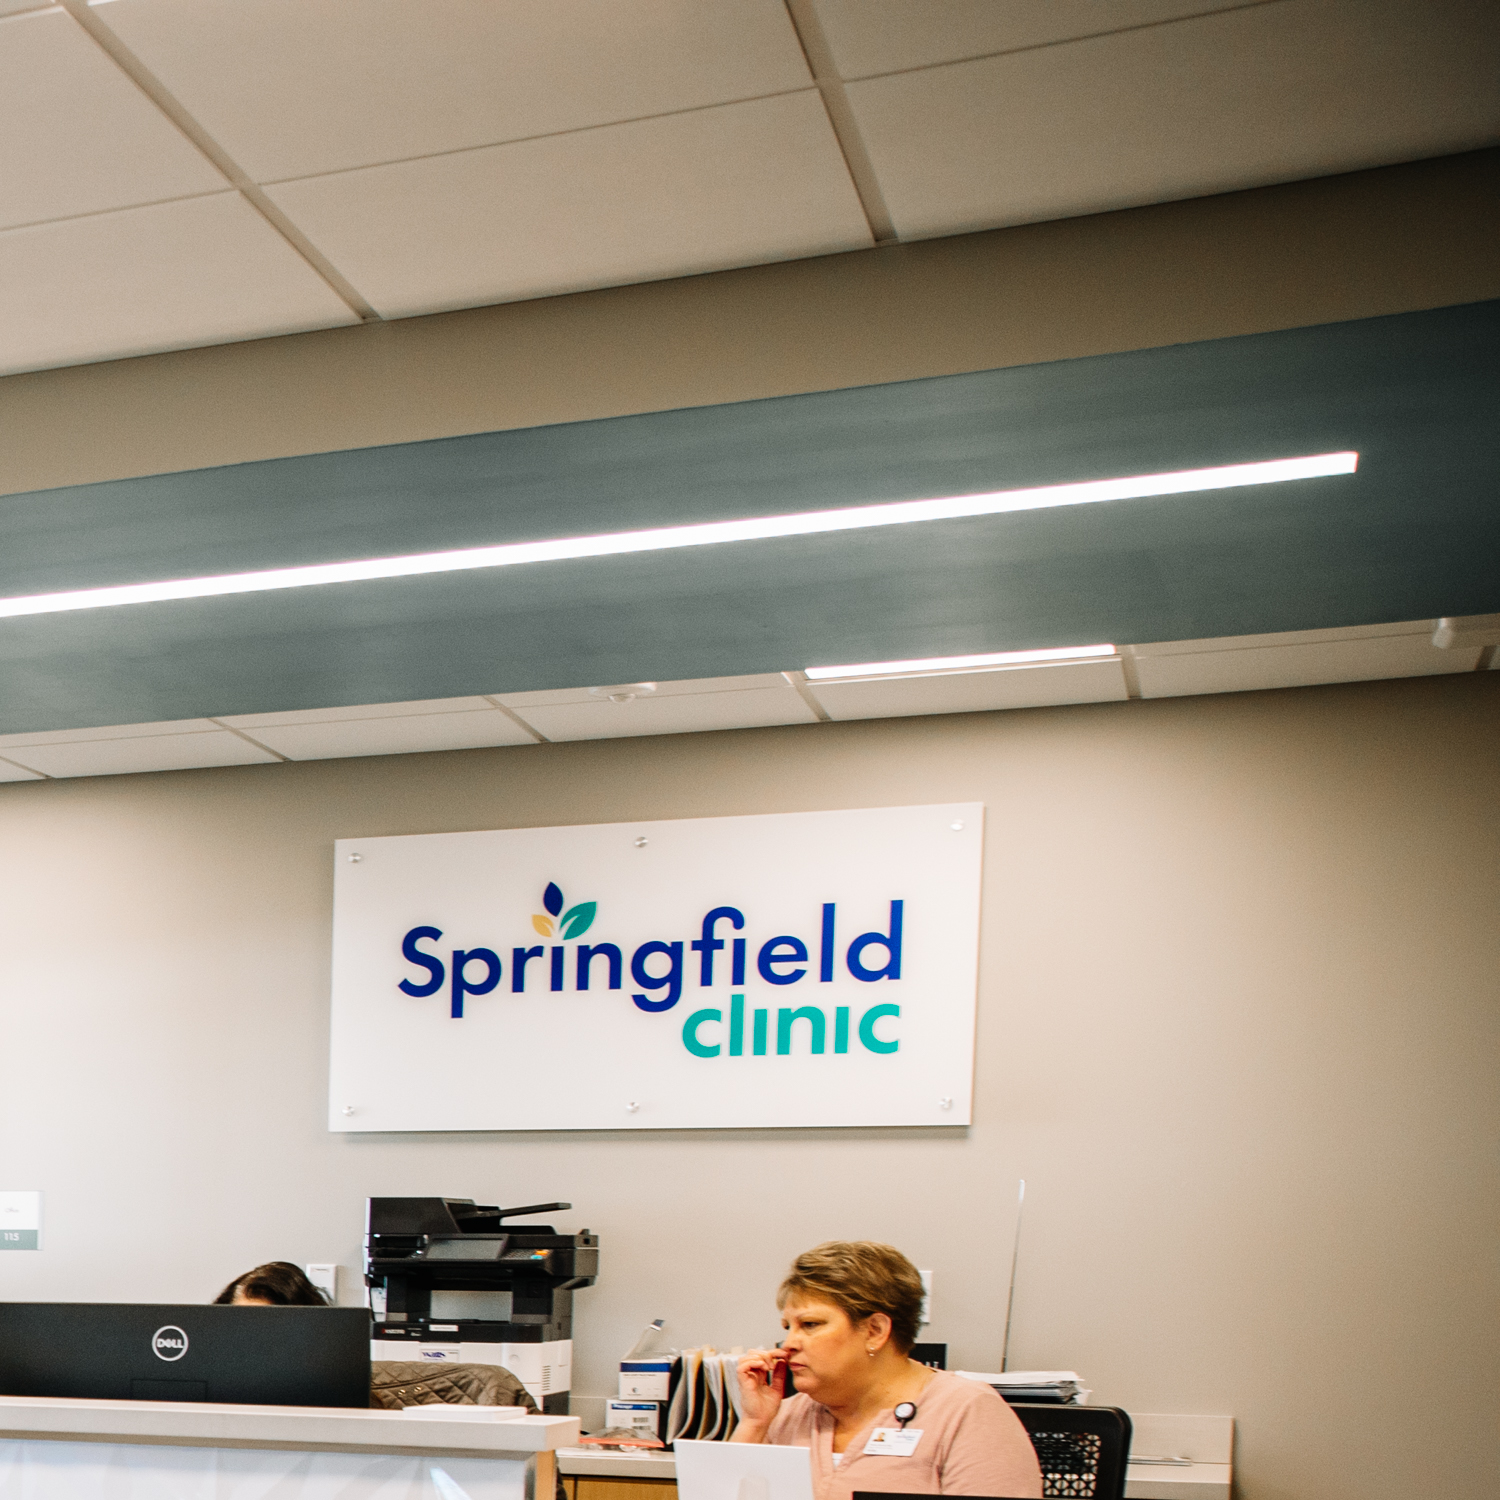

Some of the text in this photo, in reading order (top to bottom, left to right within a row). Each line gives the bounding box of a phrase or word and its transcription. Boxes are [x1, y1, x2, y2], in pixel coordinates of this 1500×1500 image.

[397, 899, 905, 1019] Springfield
[681, 993, 903, 1059] clinic
[4, 1232, 20, 1241] 115
